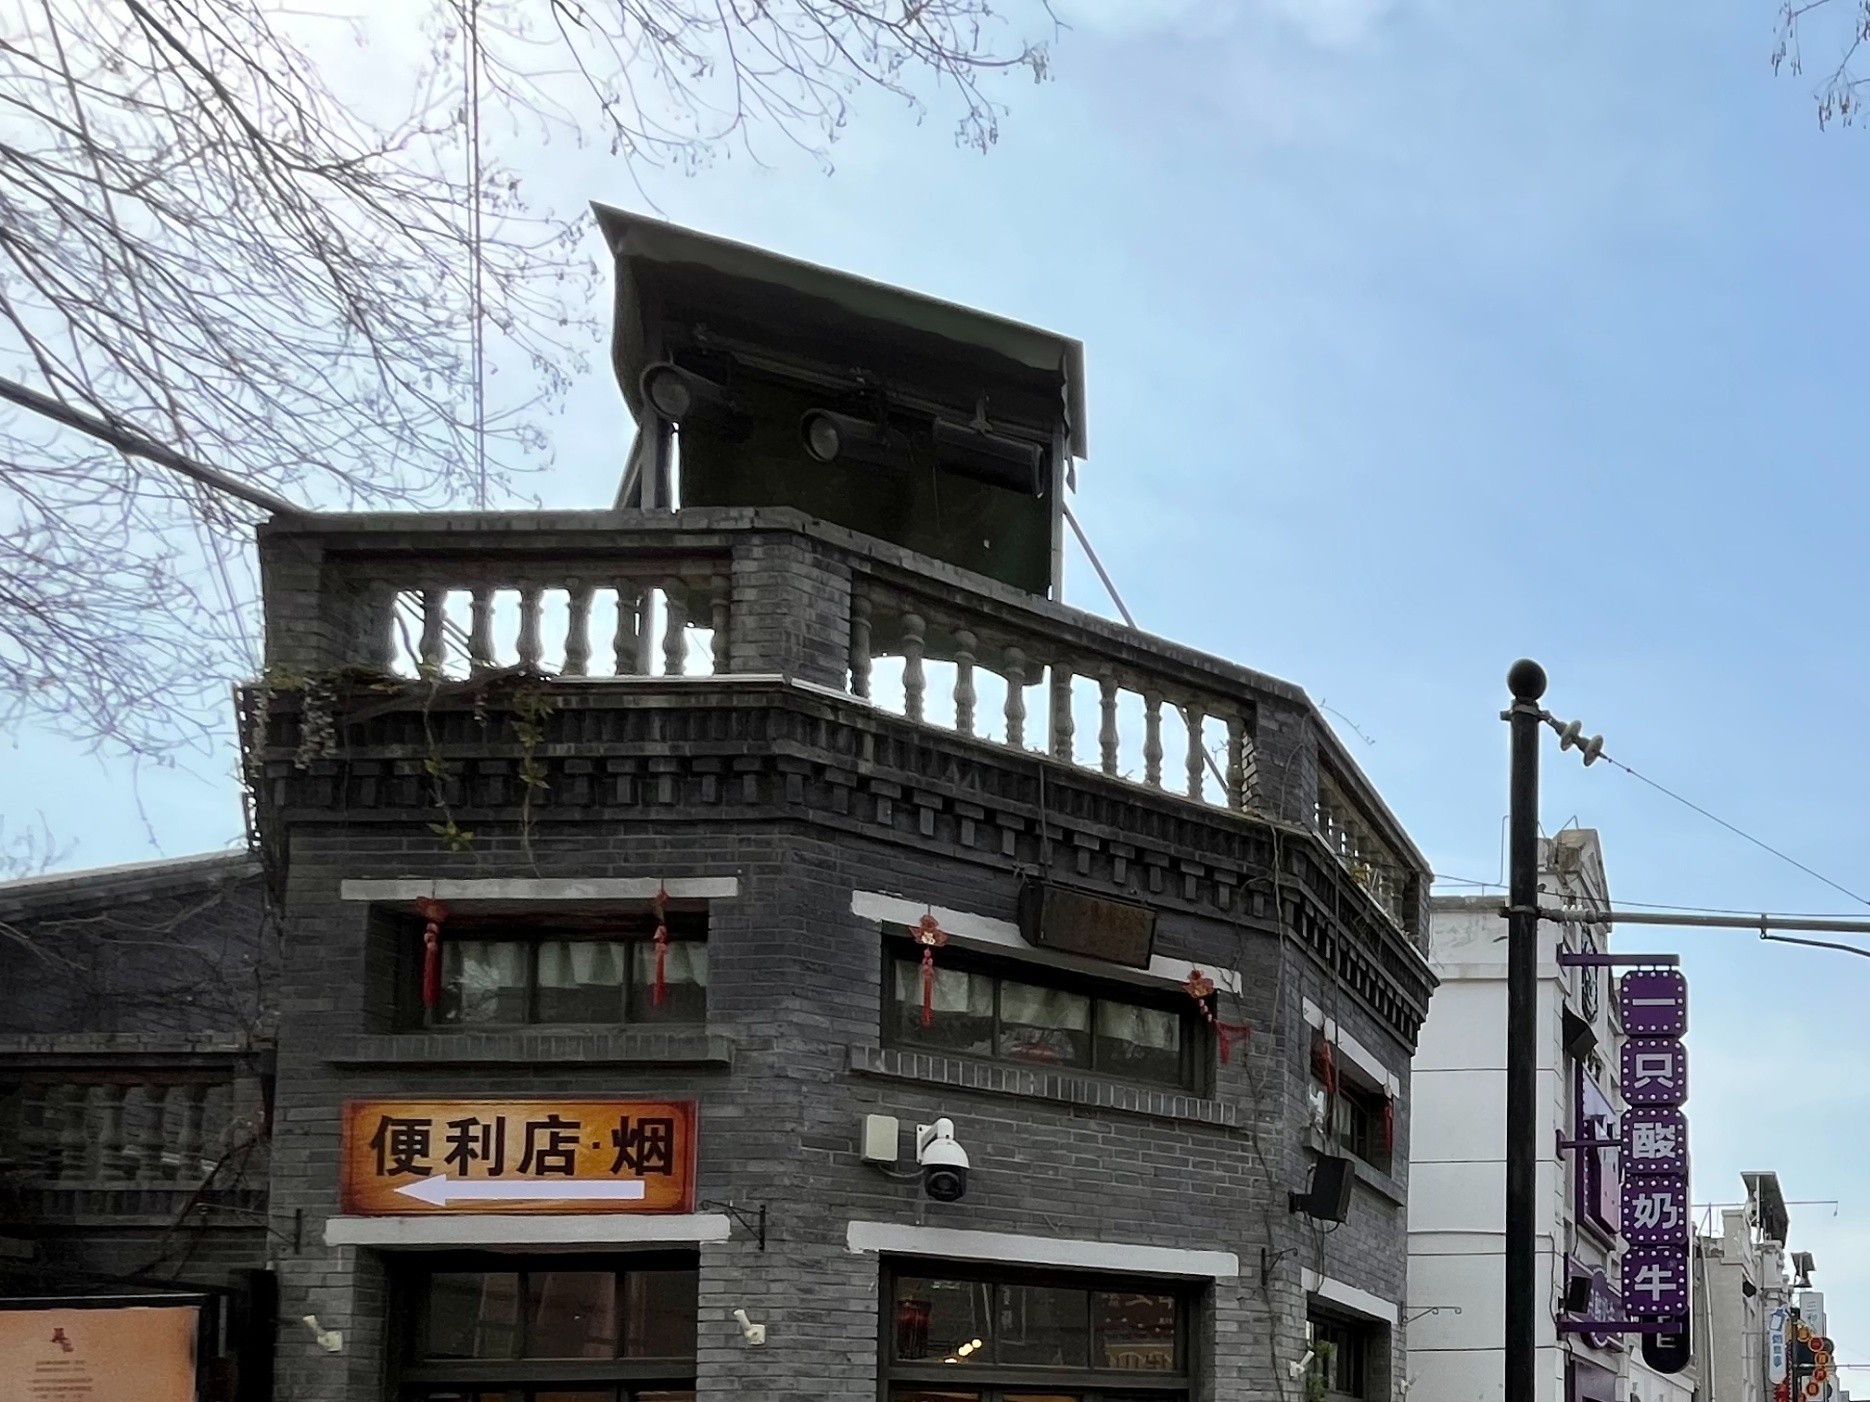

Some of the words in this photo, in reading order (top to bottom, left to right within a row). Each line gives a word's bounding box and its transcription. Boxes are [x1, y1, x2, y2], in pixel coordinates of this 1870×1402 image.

[1632, 998, 1678, 1302] 一只酸奶牛
